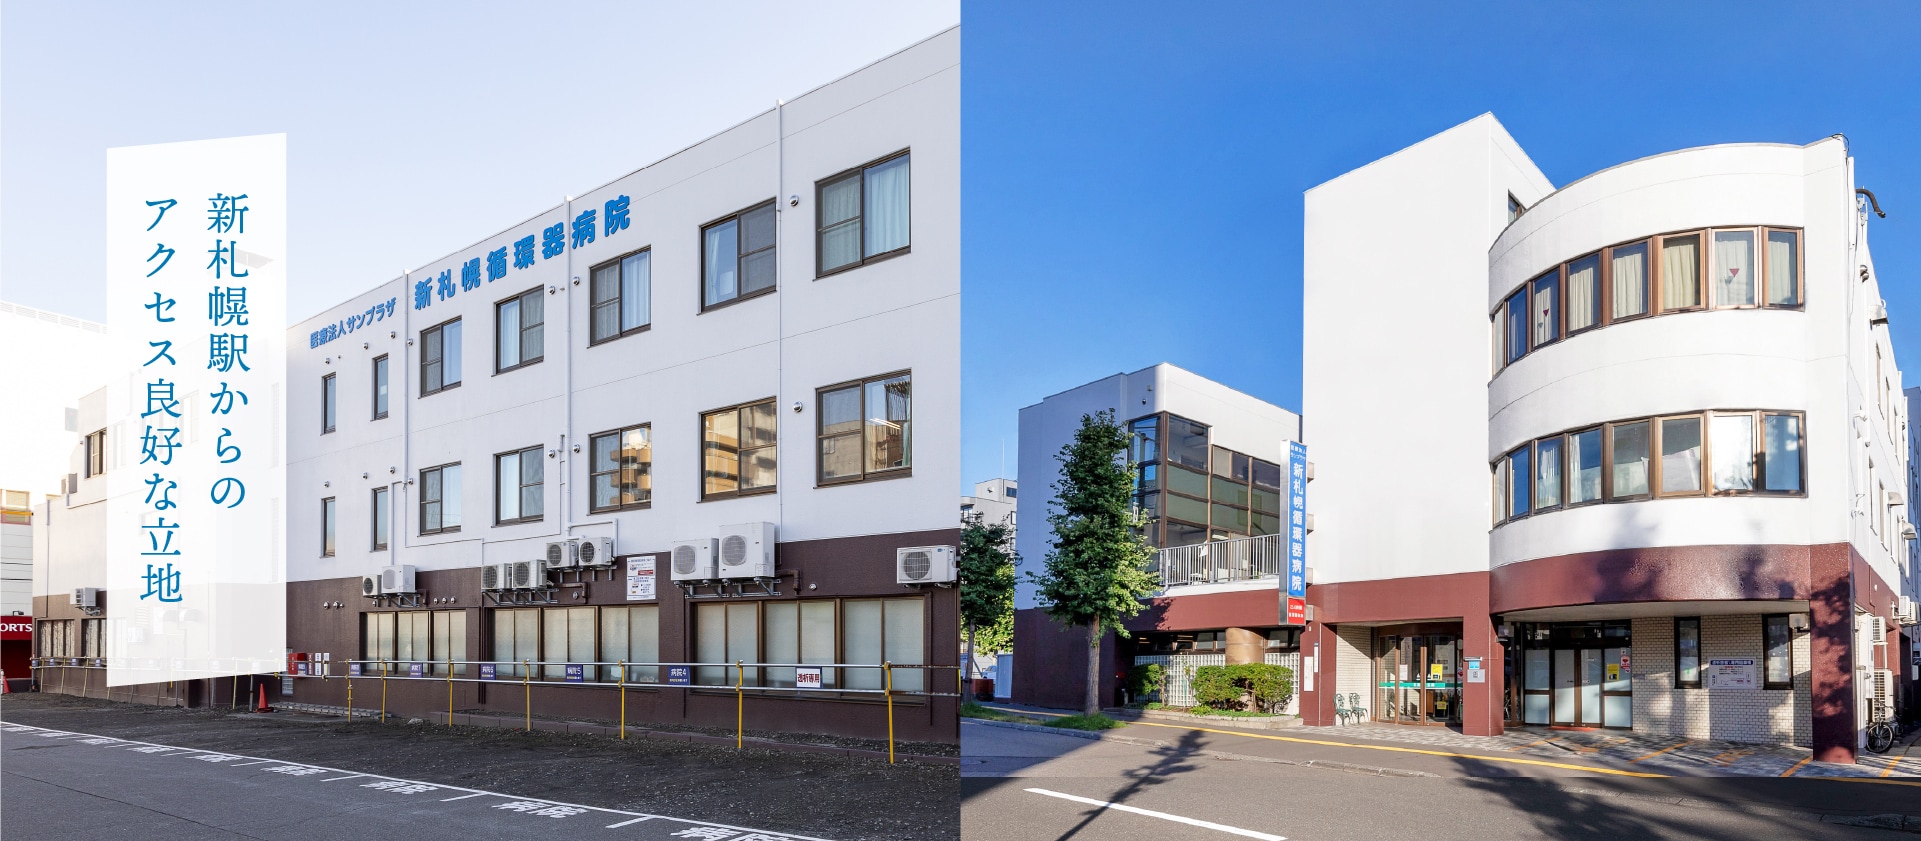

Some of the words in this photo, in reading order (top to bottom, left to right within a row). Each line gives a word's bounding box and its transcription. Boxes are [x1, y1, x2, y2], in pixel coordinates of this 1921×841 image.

[414, 194, 631, 310] 新札幌循環器病院
[310, 296, 396, 349] 医療法人サンプラザ
[1291, 462, 1304, 591] 新札幌循環器病院
[670, 668, 687, 676] 病院4
